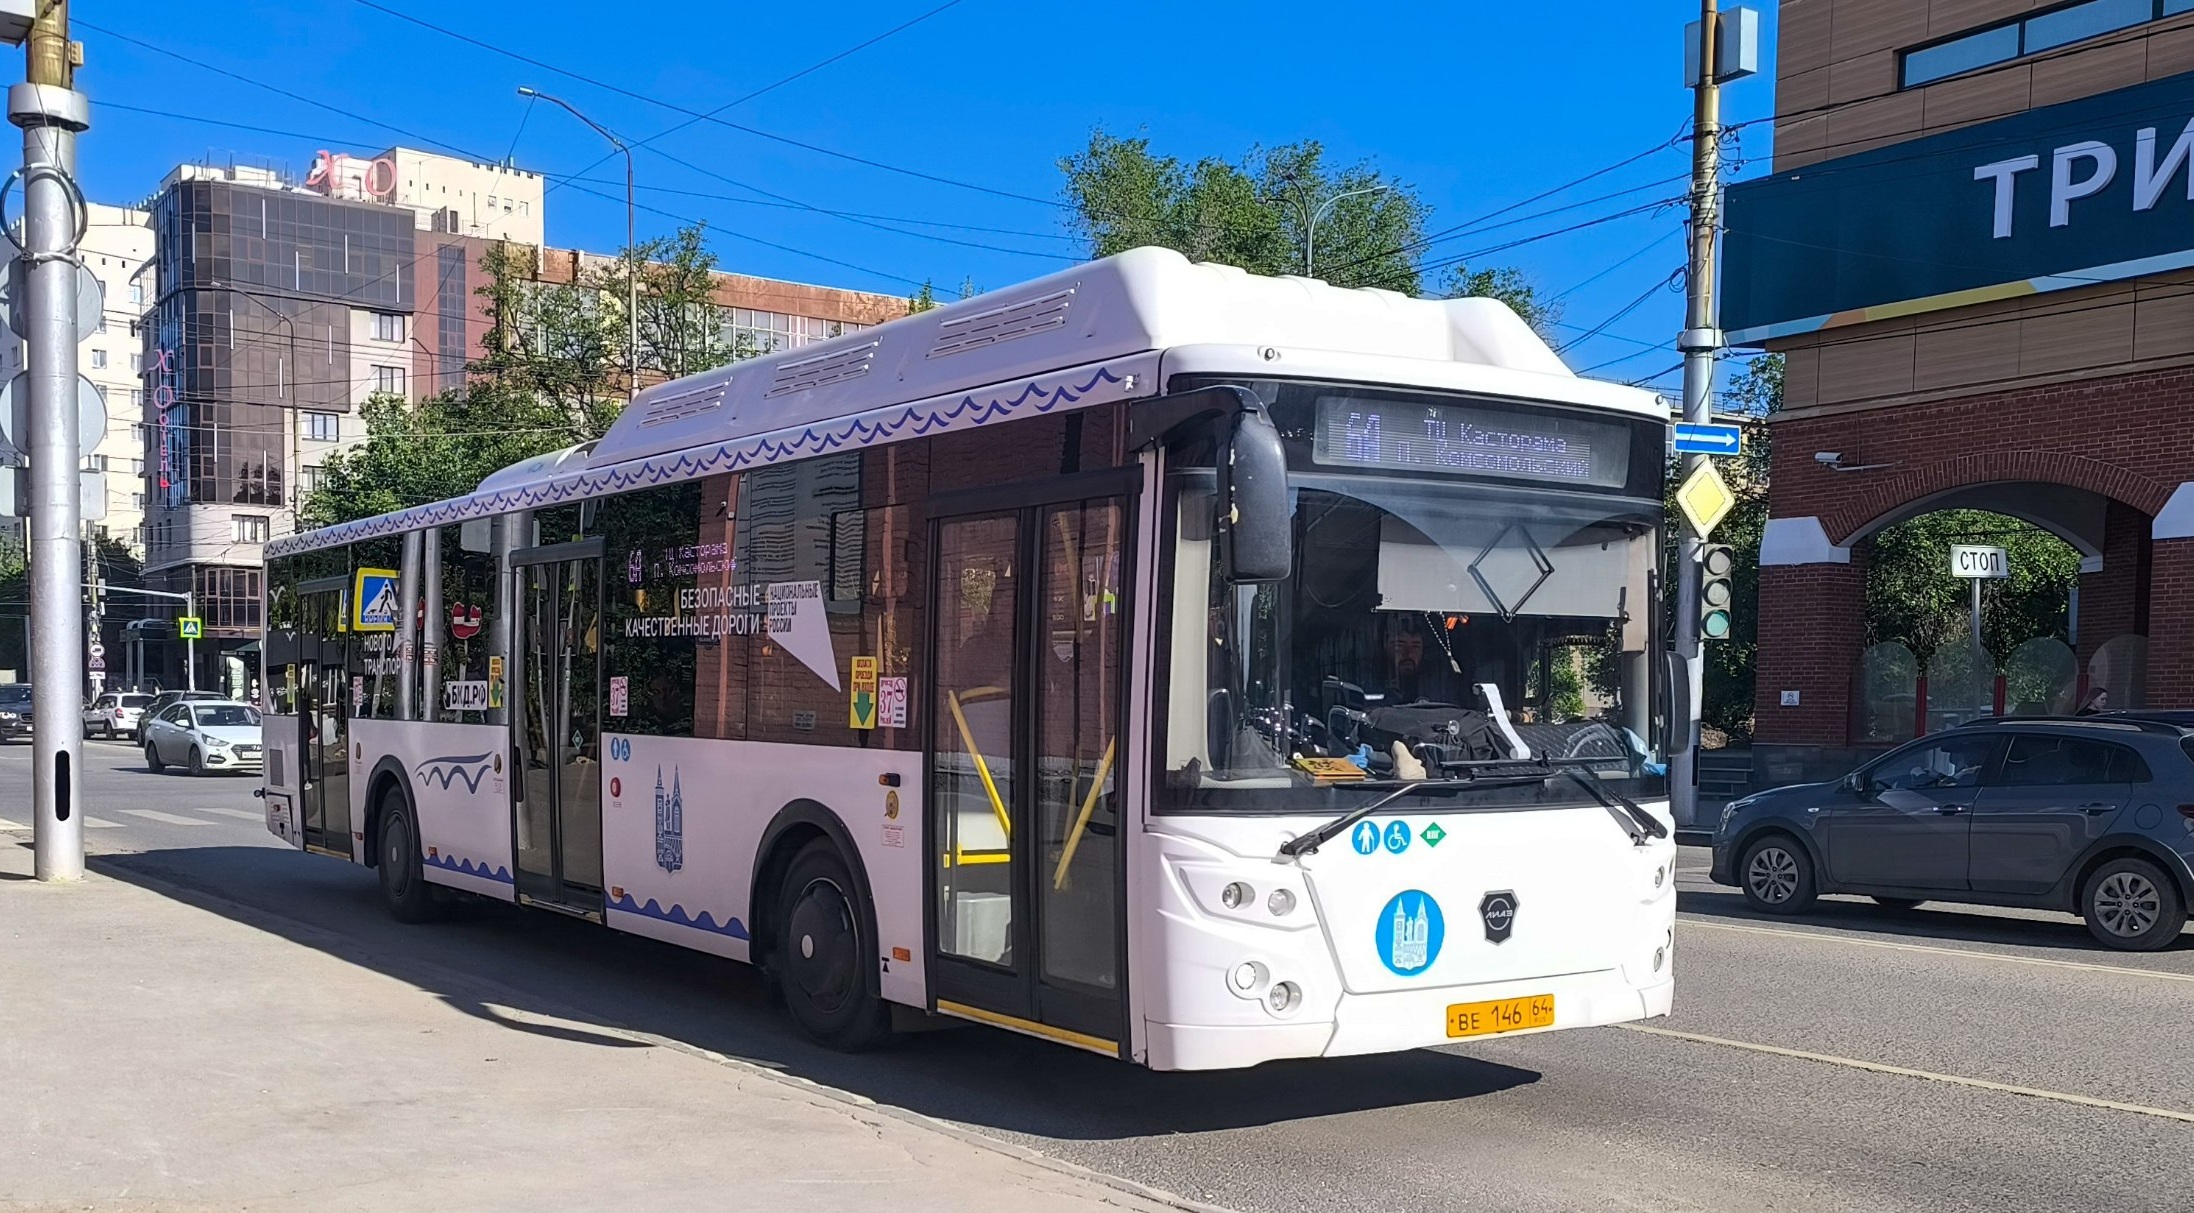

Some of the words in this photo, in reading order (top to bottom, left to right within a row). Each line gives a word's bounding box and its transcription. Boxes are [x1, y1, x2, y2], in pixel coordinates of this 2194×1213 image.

[1974, 110, 2194, 239] ТРИ
[1460, 422, 1567, 454] Касторама
[1436, 442, 1590, 477] Комсомольский
[1960, 550, 2000, 571] СТОП
[680, 584, 761, 610] БЕЗОПАСНЫЕ
[769, 582, 819, 601] НАЦИОНАЛЬНЫЕ
[769, 601, 797, 617] ПРОЕКТЫ
[625, 615, 710, 638] КАЧЕСТВЕННЫЕ
[711, 613, 760, 640] ДОРОГИ
[769, 617, 792, 633] РОССИИ
[364, 634, 392, 653] НОВОГО
[364, 657, 401, 676] ТРАНСПОР
[452, 684, 486, 708] БКД.РФ
[880, 690, 893, 714] 37
[1491, 1002, 1522, 1027] 146
[1532, 998, 1548, 1016] 64
